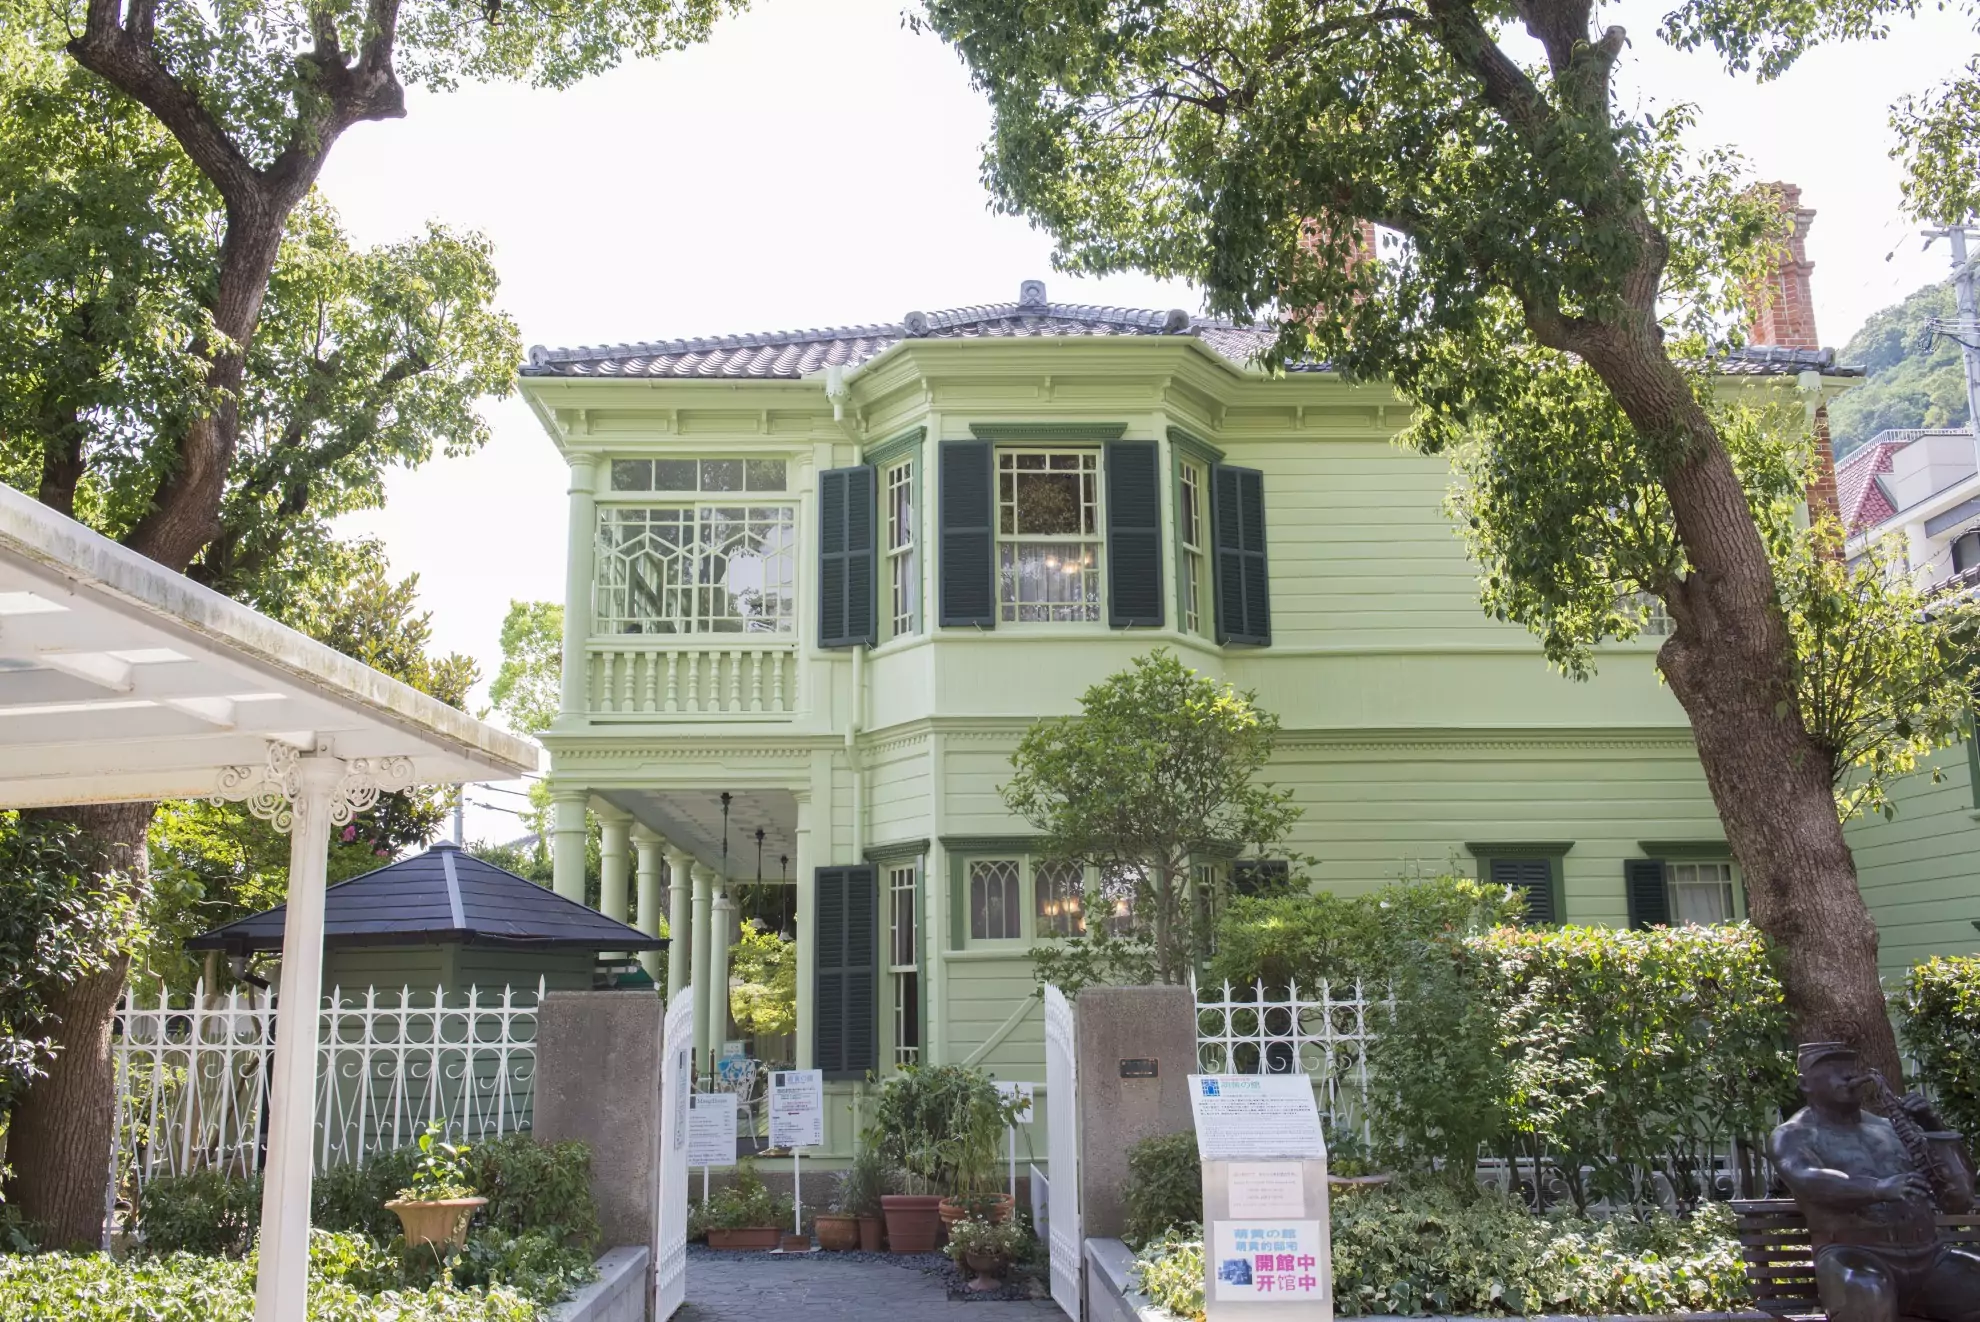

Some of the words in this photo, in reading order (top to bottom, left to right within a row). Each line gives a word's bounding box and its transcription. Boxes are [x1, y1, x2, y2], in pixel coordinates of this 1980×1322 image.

[1255, 1254, 1315, 1272] 開館中
[1256, 1274, 1316, 1292] 开馆中
